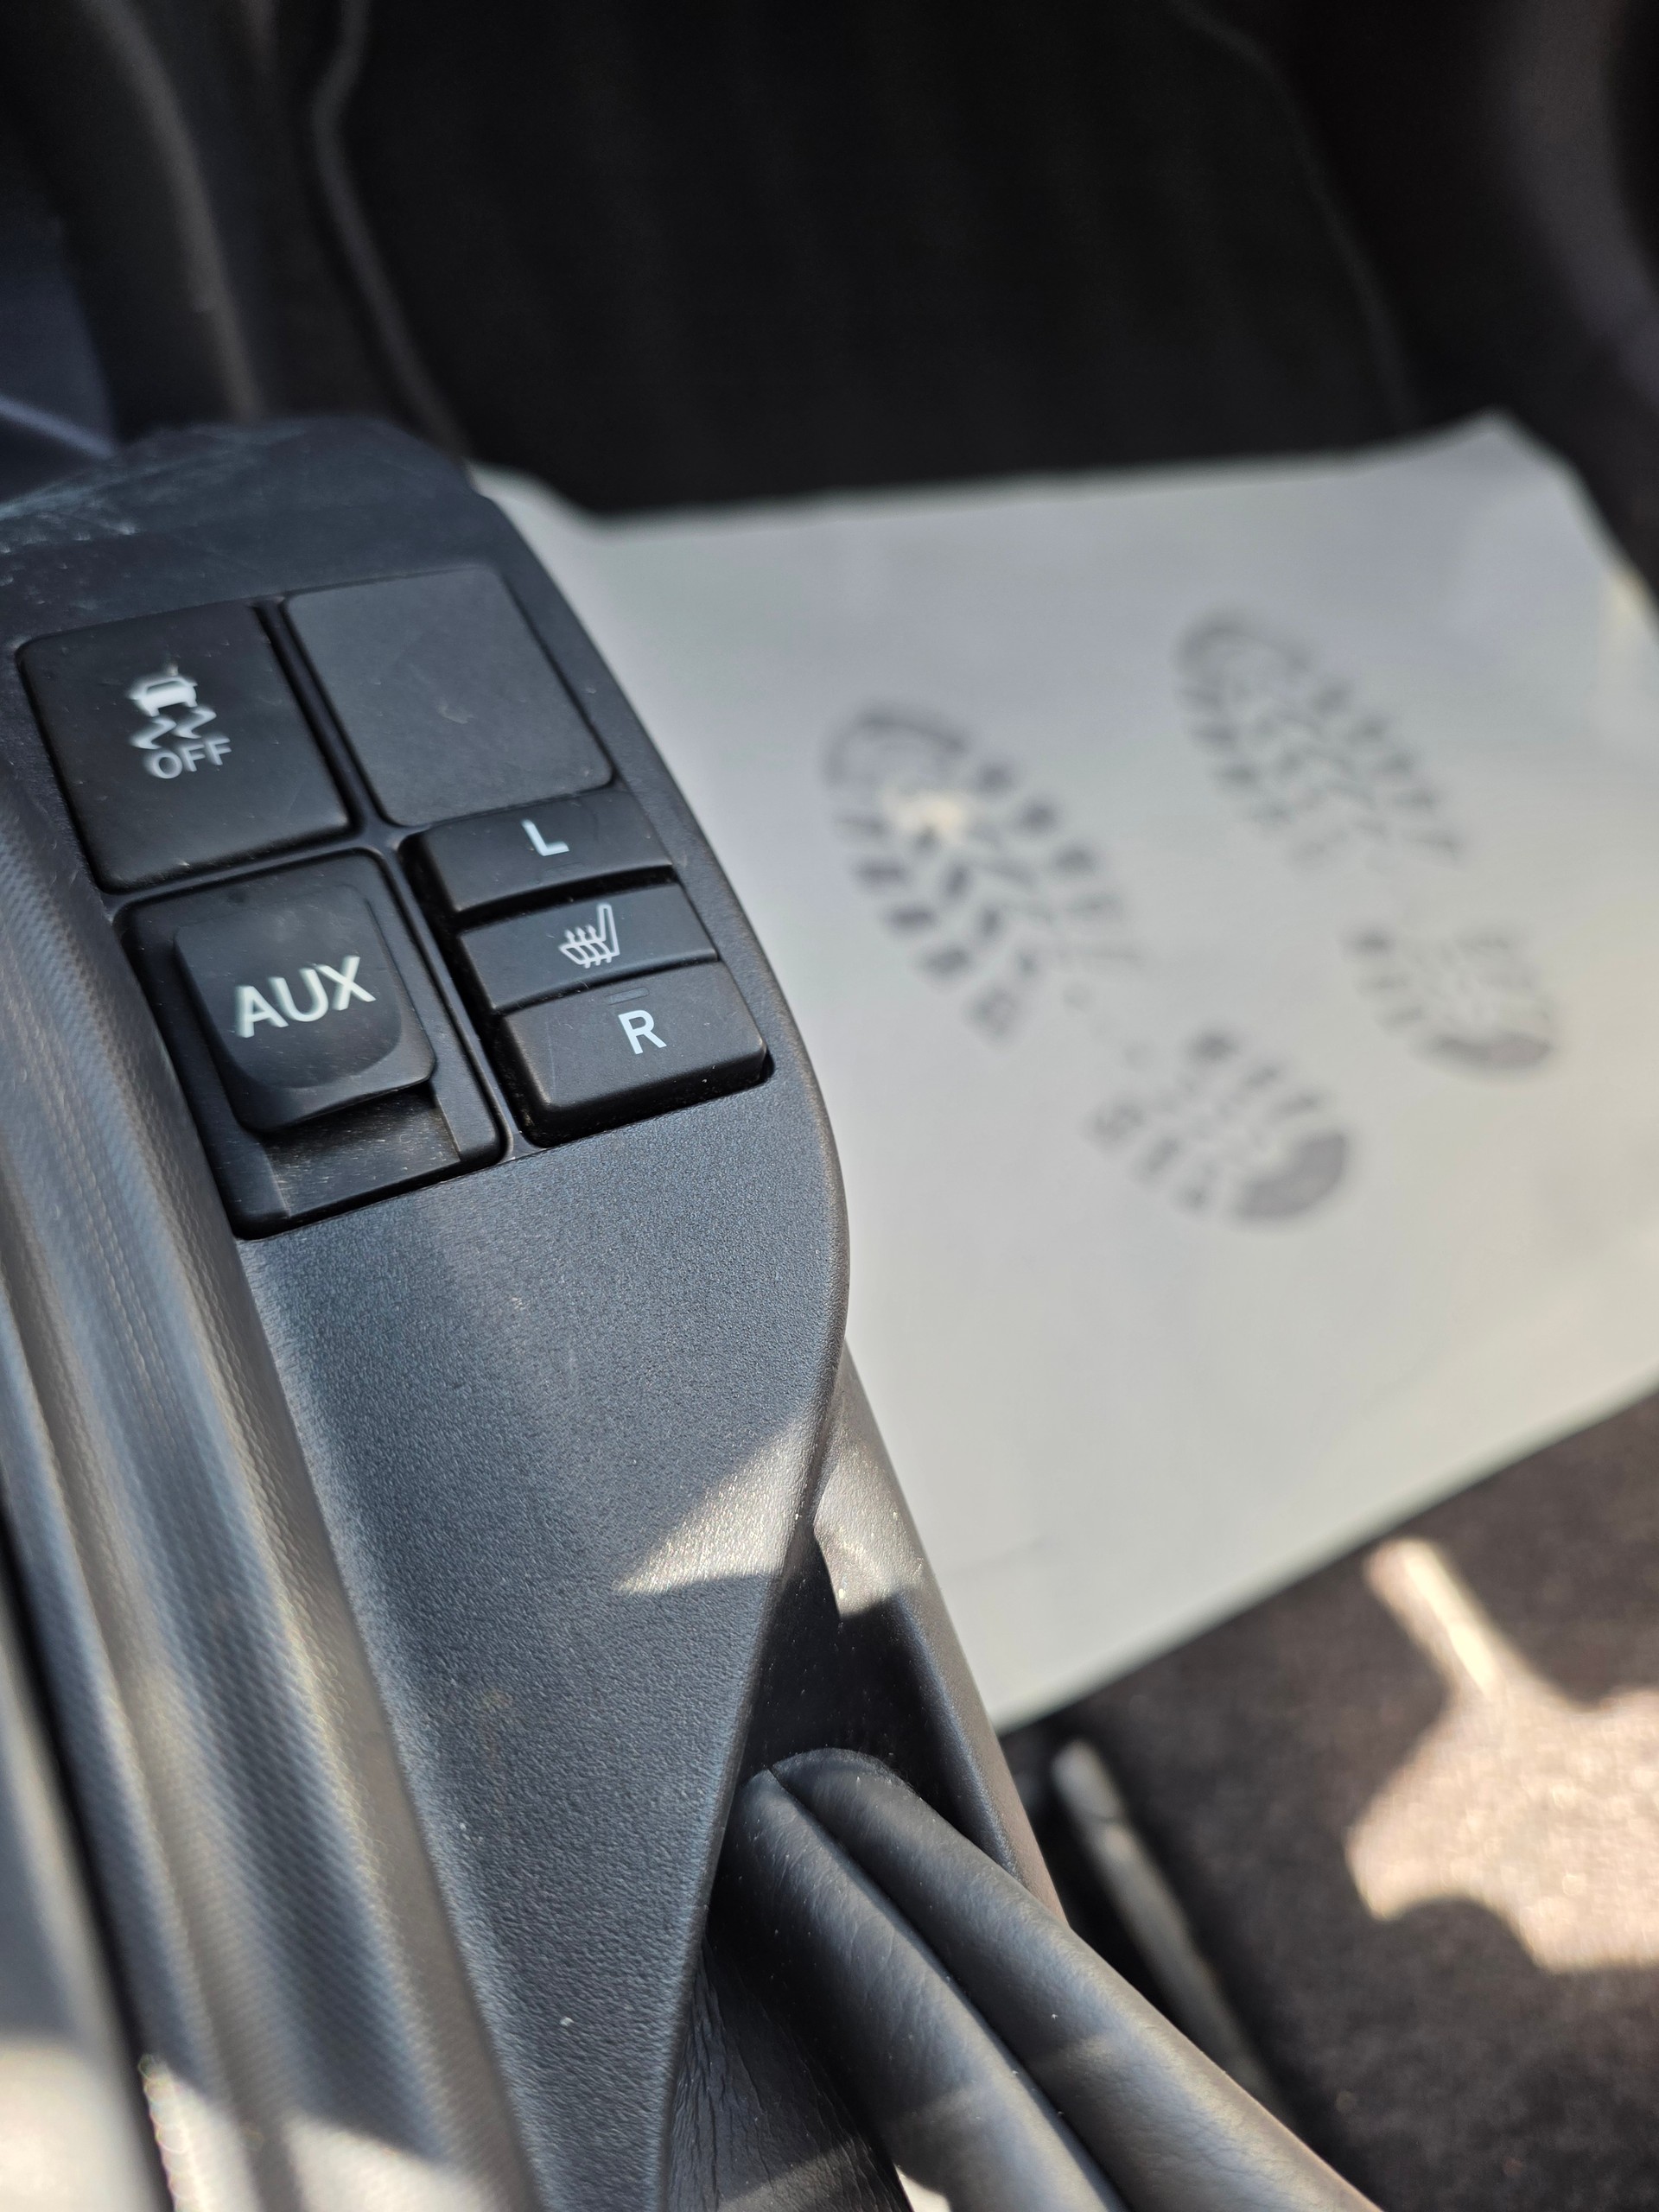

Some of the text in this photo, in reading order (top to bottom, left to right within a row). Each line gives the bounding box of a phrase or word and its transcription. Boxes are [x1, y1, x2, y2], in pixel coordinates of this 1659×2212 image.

[147, 736, 232, 779] OFF
[522, 819, 569, 856] L
[235, 955, 376, 1038] AUX
[618, 1009, 667, 1054] R
